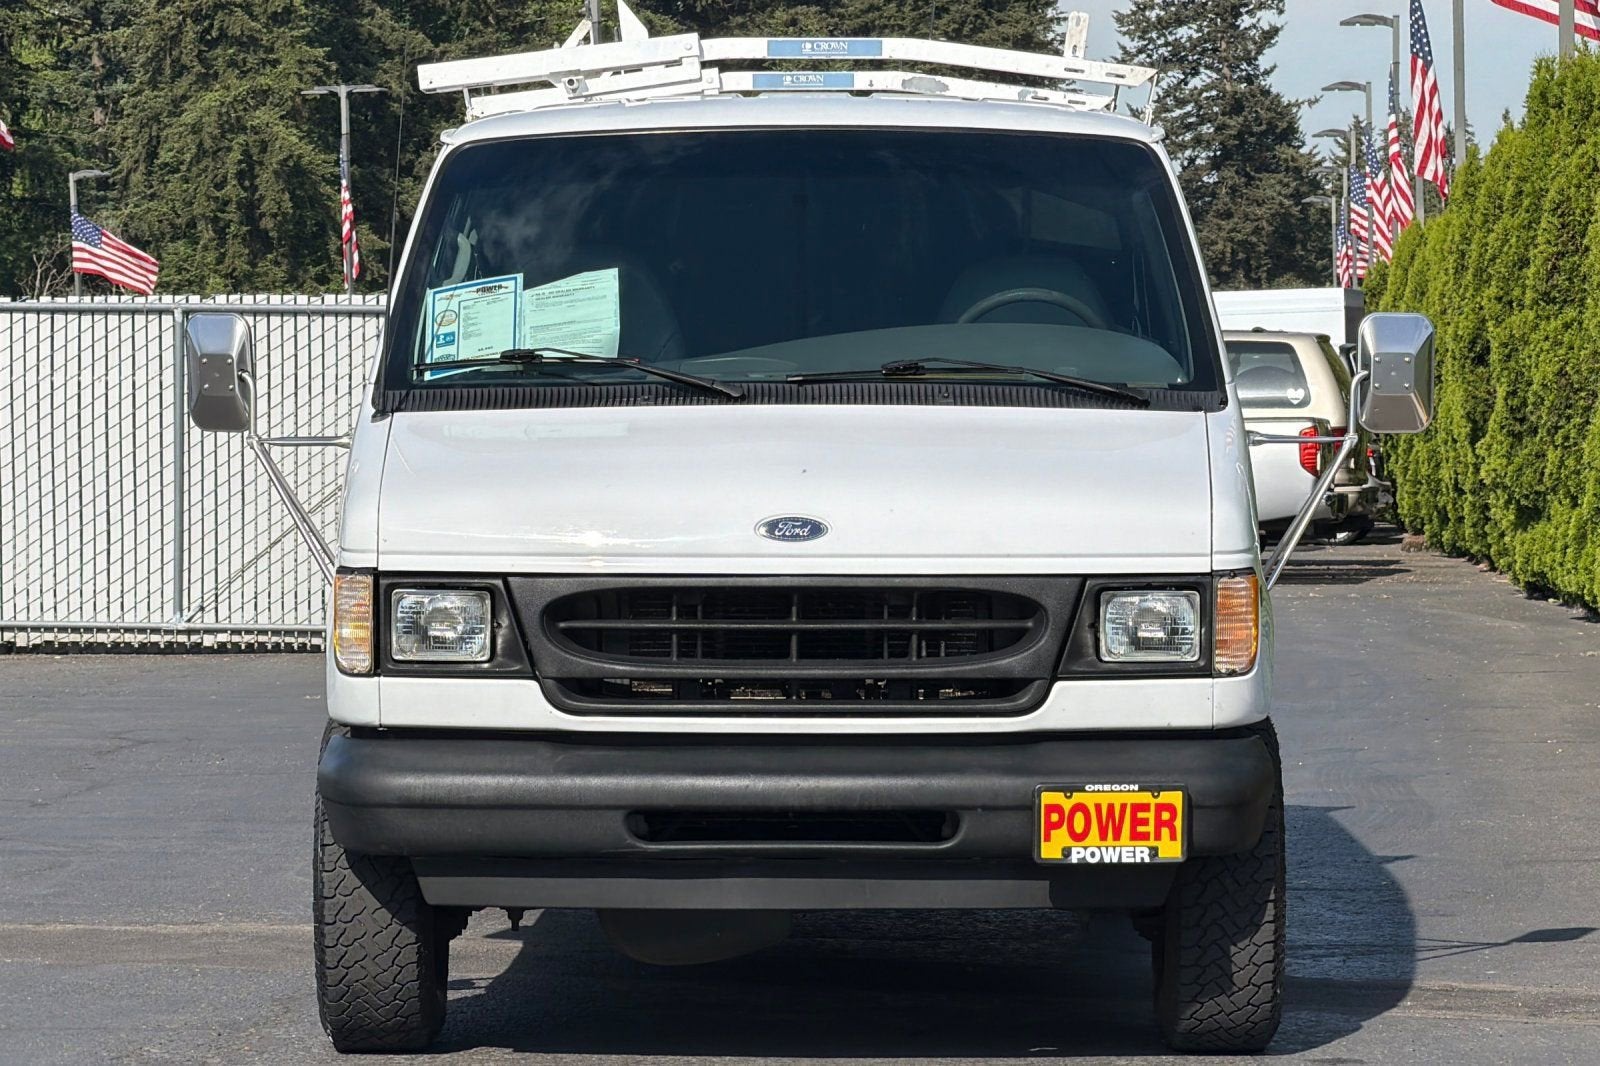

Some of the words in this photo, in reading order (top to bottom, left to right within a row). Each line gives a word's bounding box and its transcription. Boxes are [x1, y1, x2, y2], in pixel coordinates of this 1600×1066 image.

[813, 42, 848, 50] CROWN
[774, 521, 811, 537] Ford
[1085, 784, 1139, 792] OREGON
[1043, 802, 1178, 843] POWER
[1071, 846, 1151, 863] POWER
